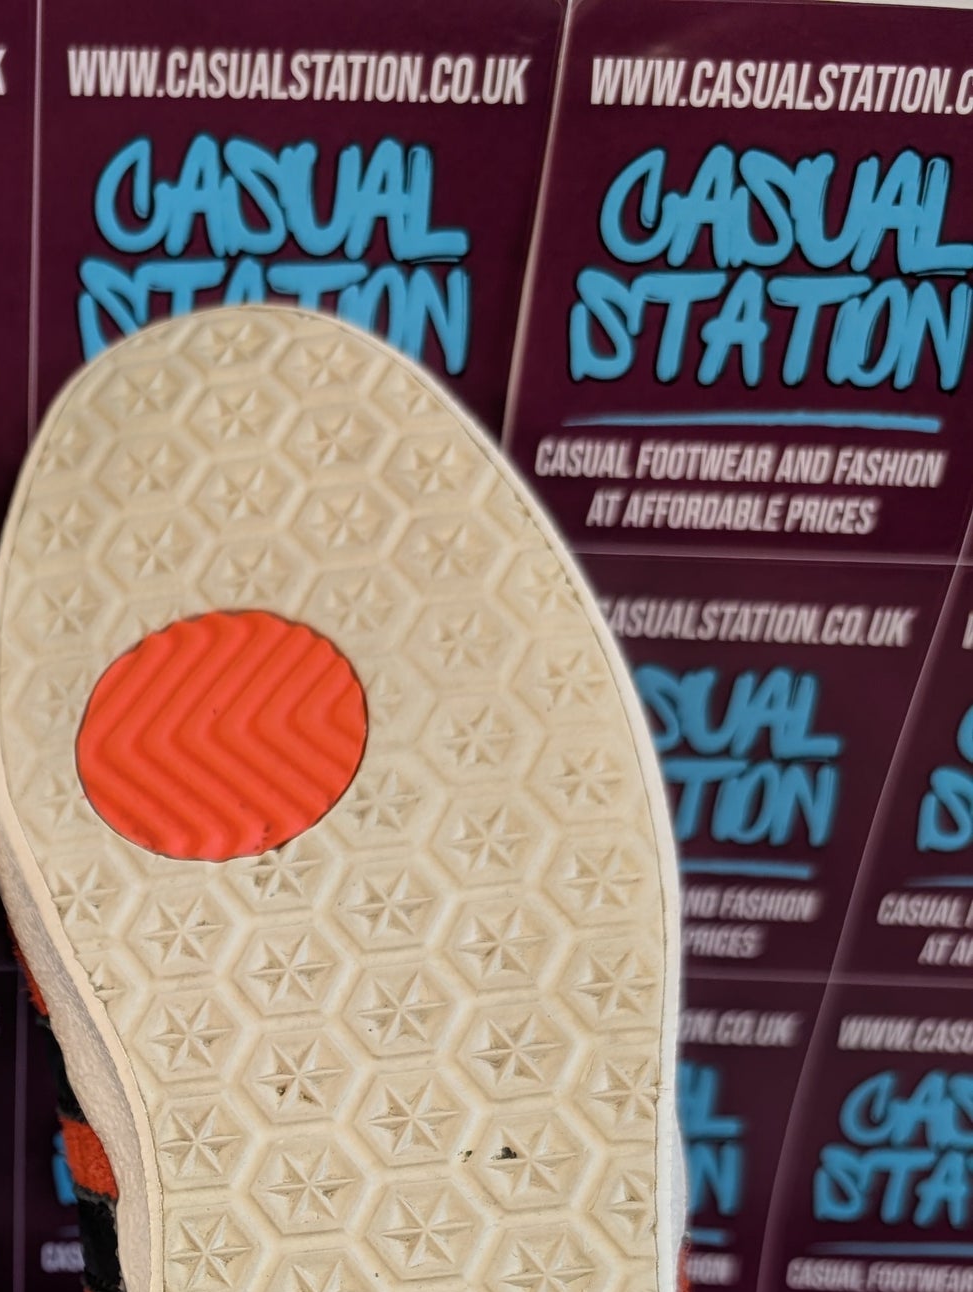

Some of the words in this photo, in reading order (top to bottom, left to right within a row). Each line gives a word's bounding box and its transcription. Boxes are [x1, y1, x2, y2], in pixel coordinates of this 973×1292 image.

[68, 48, 531, 104] WWW.CASUALSTATION.CO.UK
[590, 57, 973, 116] WWW.CASUALSTATION.C
[95, 133, 470, 263] CASUAL
[600, 144, 973, 277] CASUAL
[569, 266, 973, 390] STATION
[534, 435, 631, 480] CASUAL
[634, 438, 777, 484] FOOTWEAR
[774, 445, 834, 485] AND
[831, 446, 948, 489] FASHION
[585, 486, 625, 528] AT
[621, 489, 785, 534] AFFORDABLE
[783, 496, 879, 536] PRICES
[633, 664, 842, 761] SUAL
[661, 757, 839, 848] TION
[717, 886, 822, 923] FASHION
[877, 893, 966, 930] CASUAL
[917, 930, 953, 966] AT
